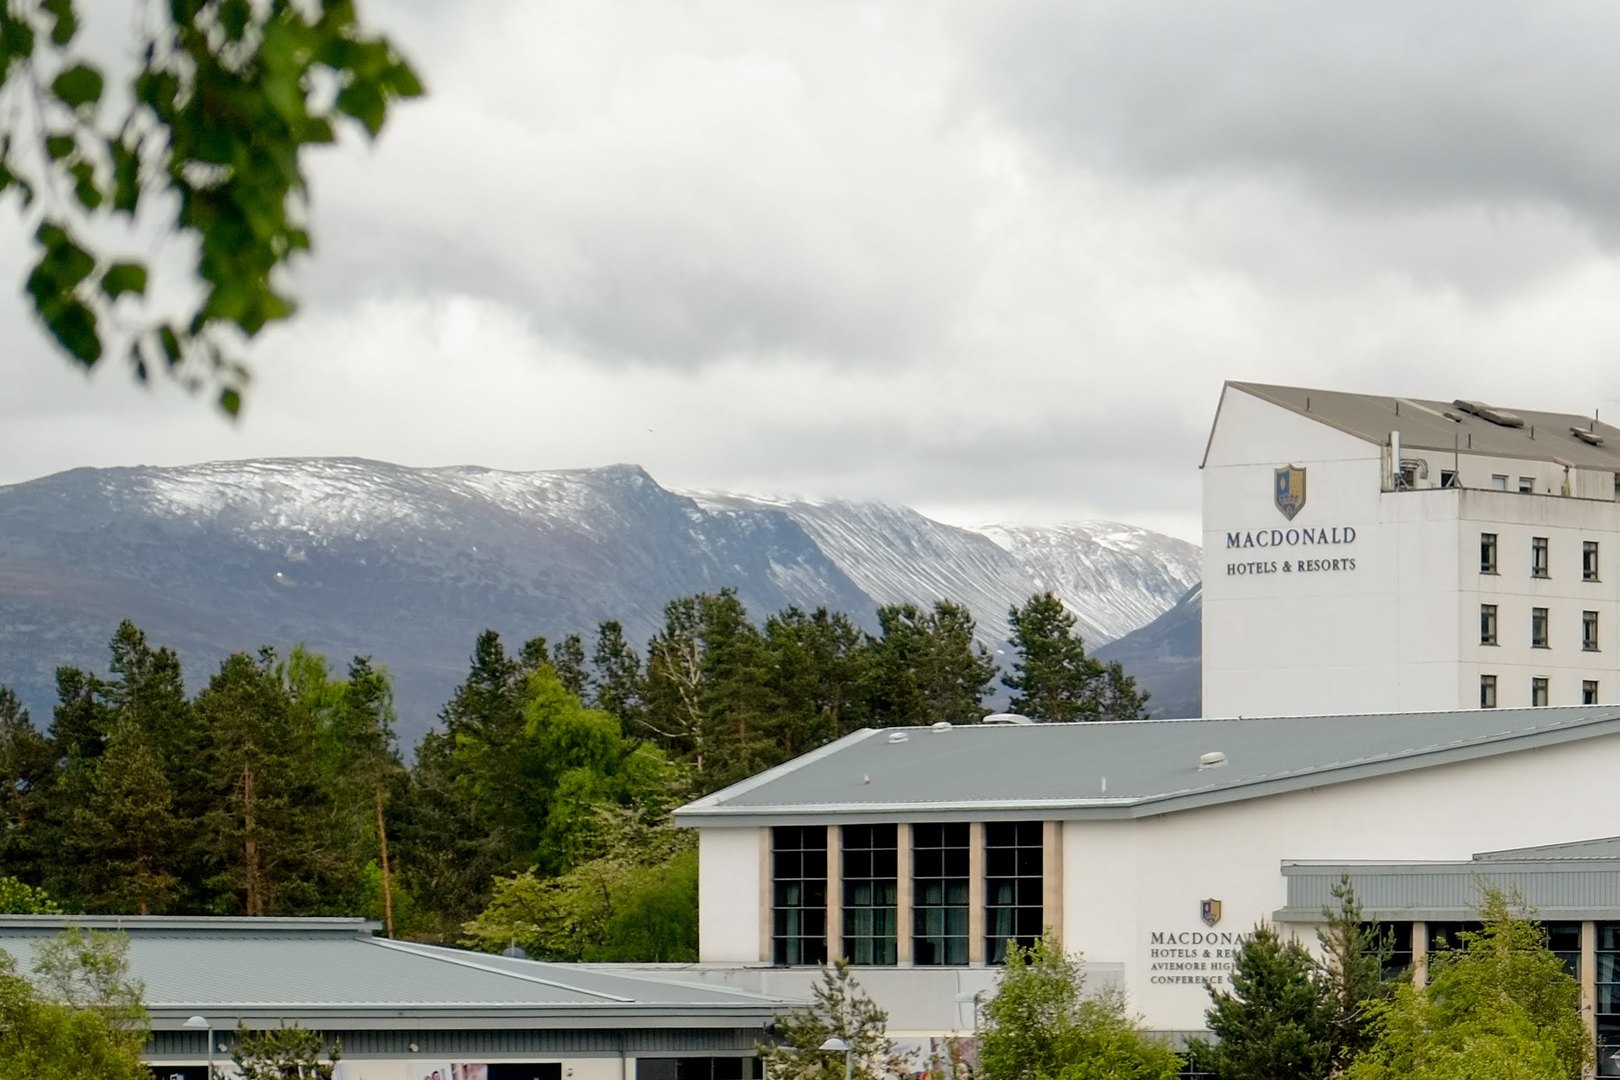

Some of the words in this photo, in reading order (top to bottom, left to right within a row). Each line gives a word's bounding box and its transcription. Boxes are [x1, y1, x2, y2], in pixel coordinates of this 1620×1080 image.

[1226, 527, 1357, 549] MACDONALD
[1227, 561, 1277, 575] HOTELS
[1282, 560, 1292, 573] &
[1298, 558, 1356, 573] RESORTS
[1151, 948, 1197, 958] HOTELS
[1202, 949, 1211, 958] &
[1151, 962, 1206, 970] AVIEMORE
[1150, 976, 1223, 984] CONFERENCE
